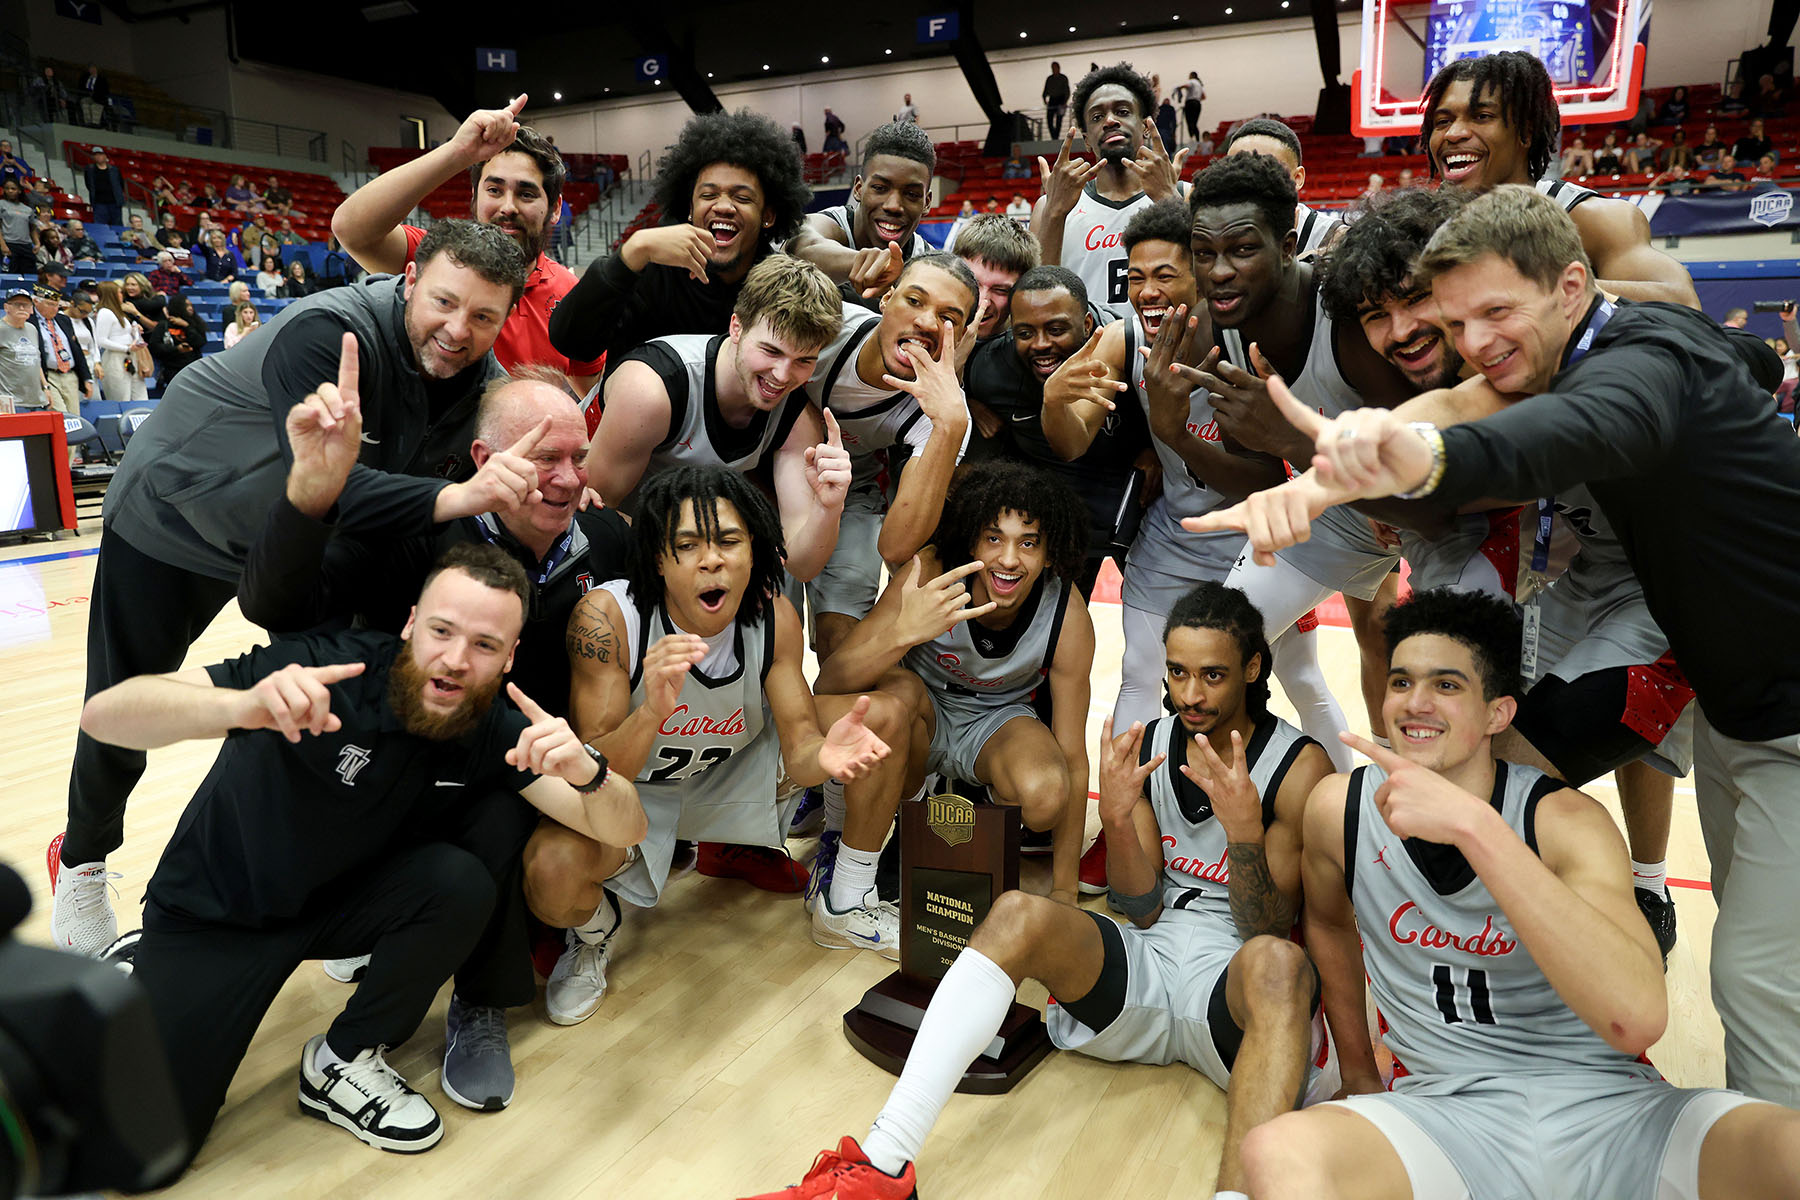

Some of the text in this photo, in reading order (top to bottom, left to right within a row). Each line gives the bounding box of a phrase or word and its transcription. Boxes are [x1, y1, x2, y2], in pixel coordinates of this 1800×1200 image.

[929, 18, 946, 38] F
[487, 53, 506, 68] H
[643, 59, 659, 75] G
[658, 703, 747, 737] Cards
[335, 744, 371, 787] TV
[928, 799, 974, 825] NJCAA
[926, 890, 974, 913] NATIONAL
[926, 902, 974, 925] CHAMPION
[916, 924, 938, 936] MEN'S
[1388, 899, 1517, 956] Cards
[1430, 962, 1498, 1025] 11
